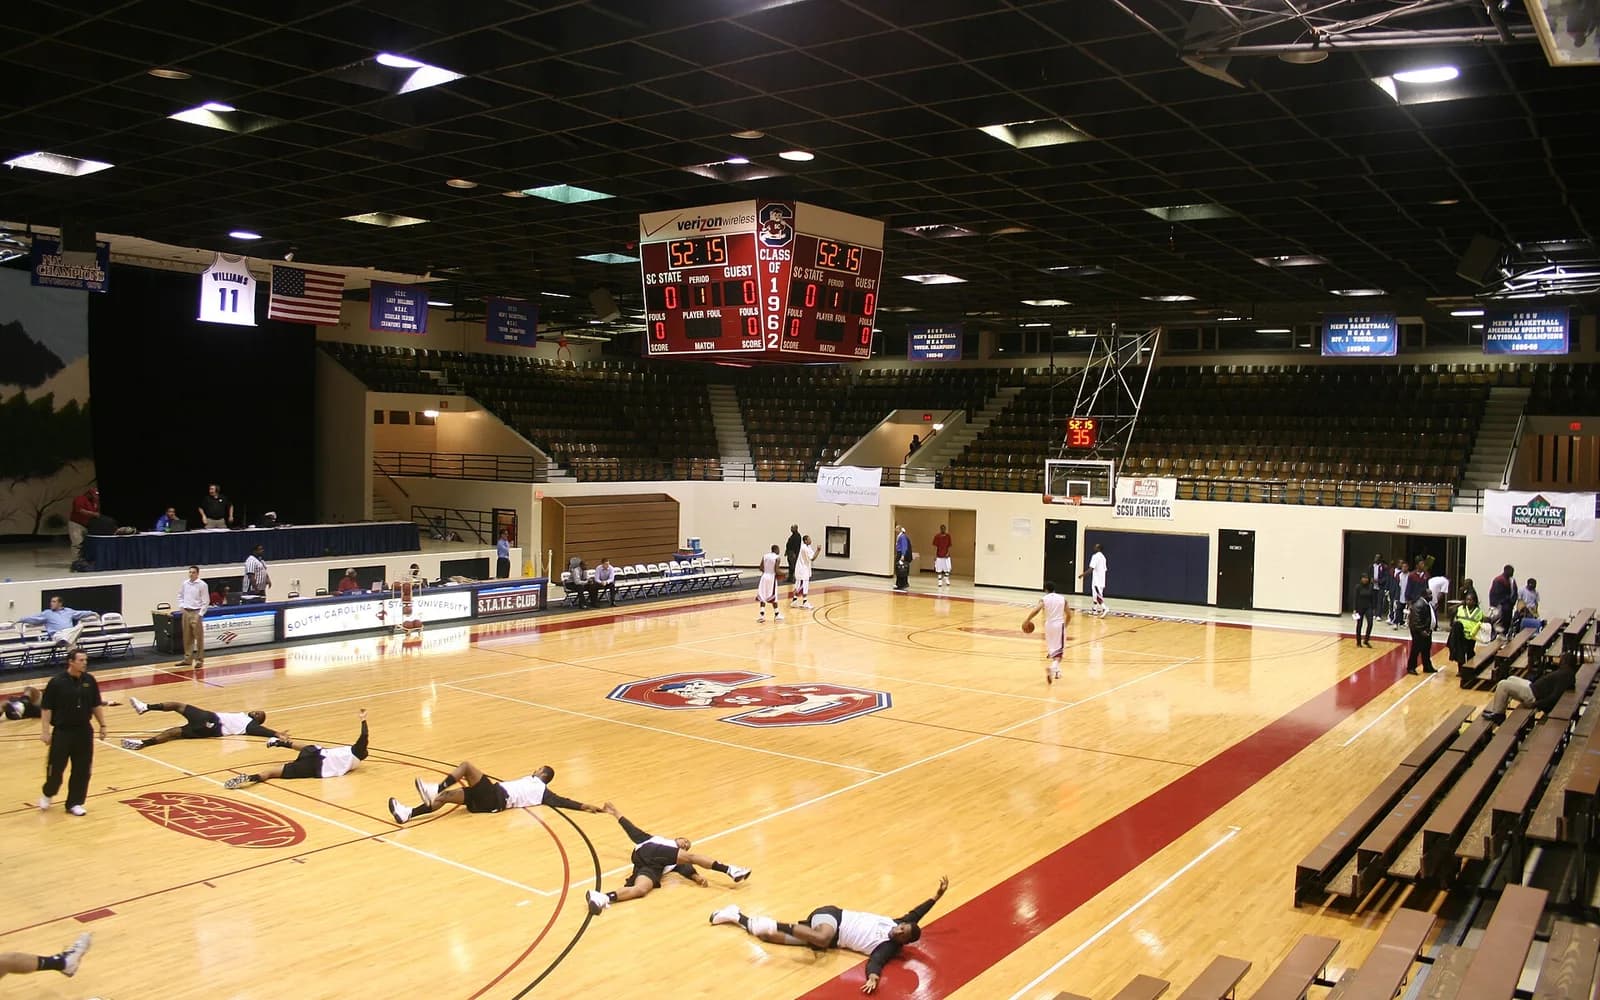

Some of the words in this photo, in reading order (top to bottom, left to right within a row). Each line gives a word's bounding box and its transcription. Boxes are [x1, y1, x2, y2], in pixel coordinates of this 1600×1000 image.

[677, 216, 722, 232] verizon
[722, 214, 756, 226] wireless
[671, 239, 724, 266] 52:15
[760, 250, 790, 261] CLASS
[820, 242, 860, 271] 52:15
[36, 265, 106, 282] CHAMPIONS
[724, 265, 752, 278] GUEST
[768, 262, 780, 274] OF
[792, 266, 802, 278] SC
[804, 268, 824, 282] STATE
[212, 272, 248, 286] WILLIAMS
[646, 273, 656, 285] SC
[658, 271, 682, 284] STATE
[688, 275, 710, 284] PERIOD
[828, 278, 844, 288] PERIOD
[855, 277, 876, 290] GUEST
[665, 286, 677, 309] 0
[701, 287, 705, 304] 1
[743, 280, 756, 304] 0
[805, 284, 817, 308] 0
[218, 288, 239, 312] 11
[834, 292, 838, 308] 1
[864, 293, 874, 316] 0
[648, 312, 666, 321] FOULS
[682, 310, 704, 320] PLAYER
[706, 309, 722, 318] FOUL
[739, 307, 758, 316] FOULS
[787, 308, 802, 318] FOULS
[816, 312, 834, 322] PLAYER
[835, 313, 846, 323] FOUL
[656, 322, 665, 340] 0
[748, 316, 758, 336] 0
[790, 318, 799, 336] 0
[861, 327, 870, 344] 0
[650, 343, 668, 352] SCORE
[694, 342, 714, 350] MATCH
[742, 340, 762, 348] SCORE
[783, 340, 800, 350] SCORE
[820, 344, 836, 352] MATCH
[1072, 430, 1090, 444] 35
[1116, 505, 1134, 516] SCSU
[1136, 506, 1170, 518] ATHLETICS
[1515, 507, 1562, 518] COUNTRY
[1500, 528, 1575, 537] ORANGEBURG
[478, 596, 514, 613] S.T.A.T.E.
[516, 594, 537, 608] CLUB
[288, 614, 321, 632] SOUTH
[324, 602, 372, 619] CAROLINA
[418, 600, 468, 612] UNIVERSITY
